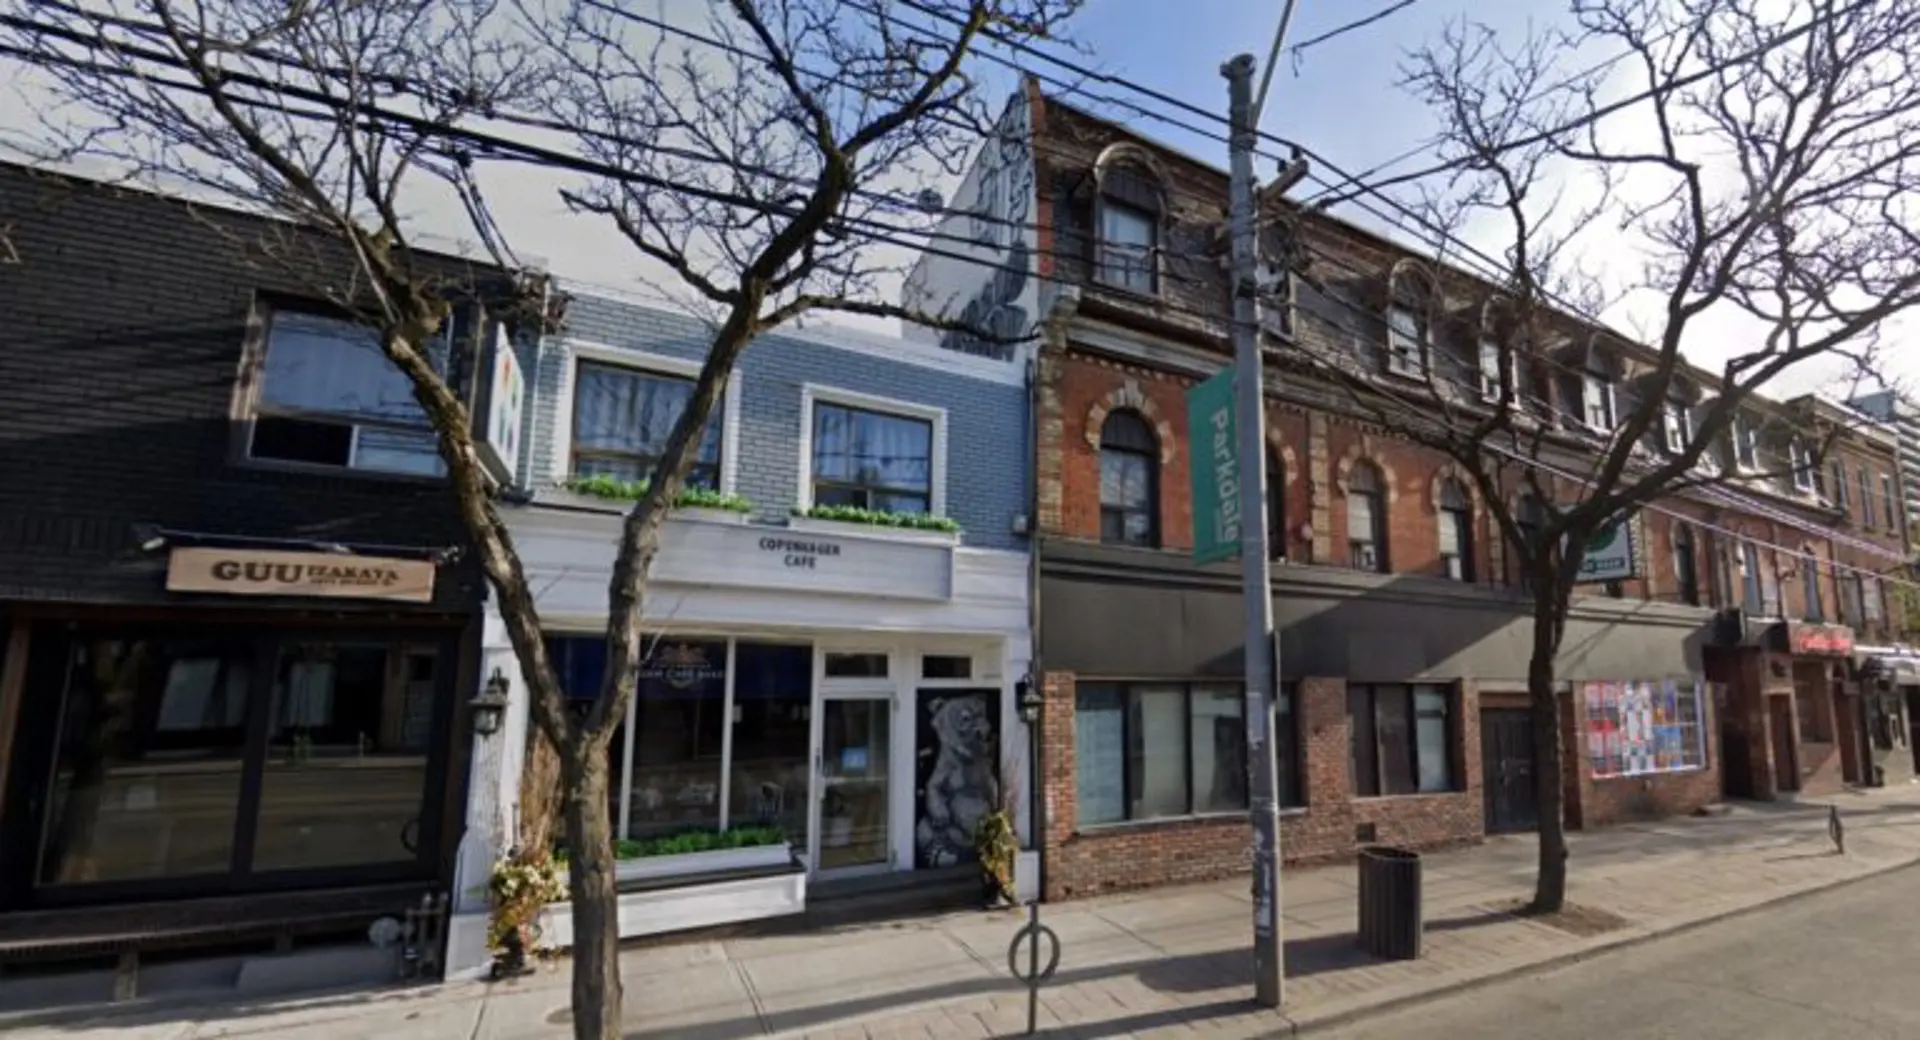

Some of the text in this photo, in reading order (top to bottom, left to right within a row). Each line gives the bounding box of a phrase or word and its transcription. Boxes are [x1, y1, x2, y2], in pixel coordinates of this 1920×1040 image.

[1209, 407, 1240, 543] Parkdale
[211, 560, 303, 583] GUU
[306, 564, 400, 581] IZAKAYA
[784, 554, 816, 569] CAFE
